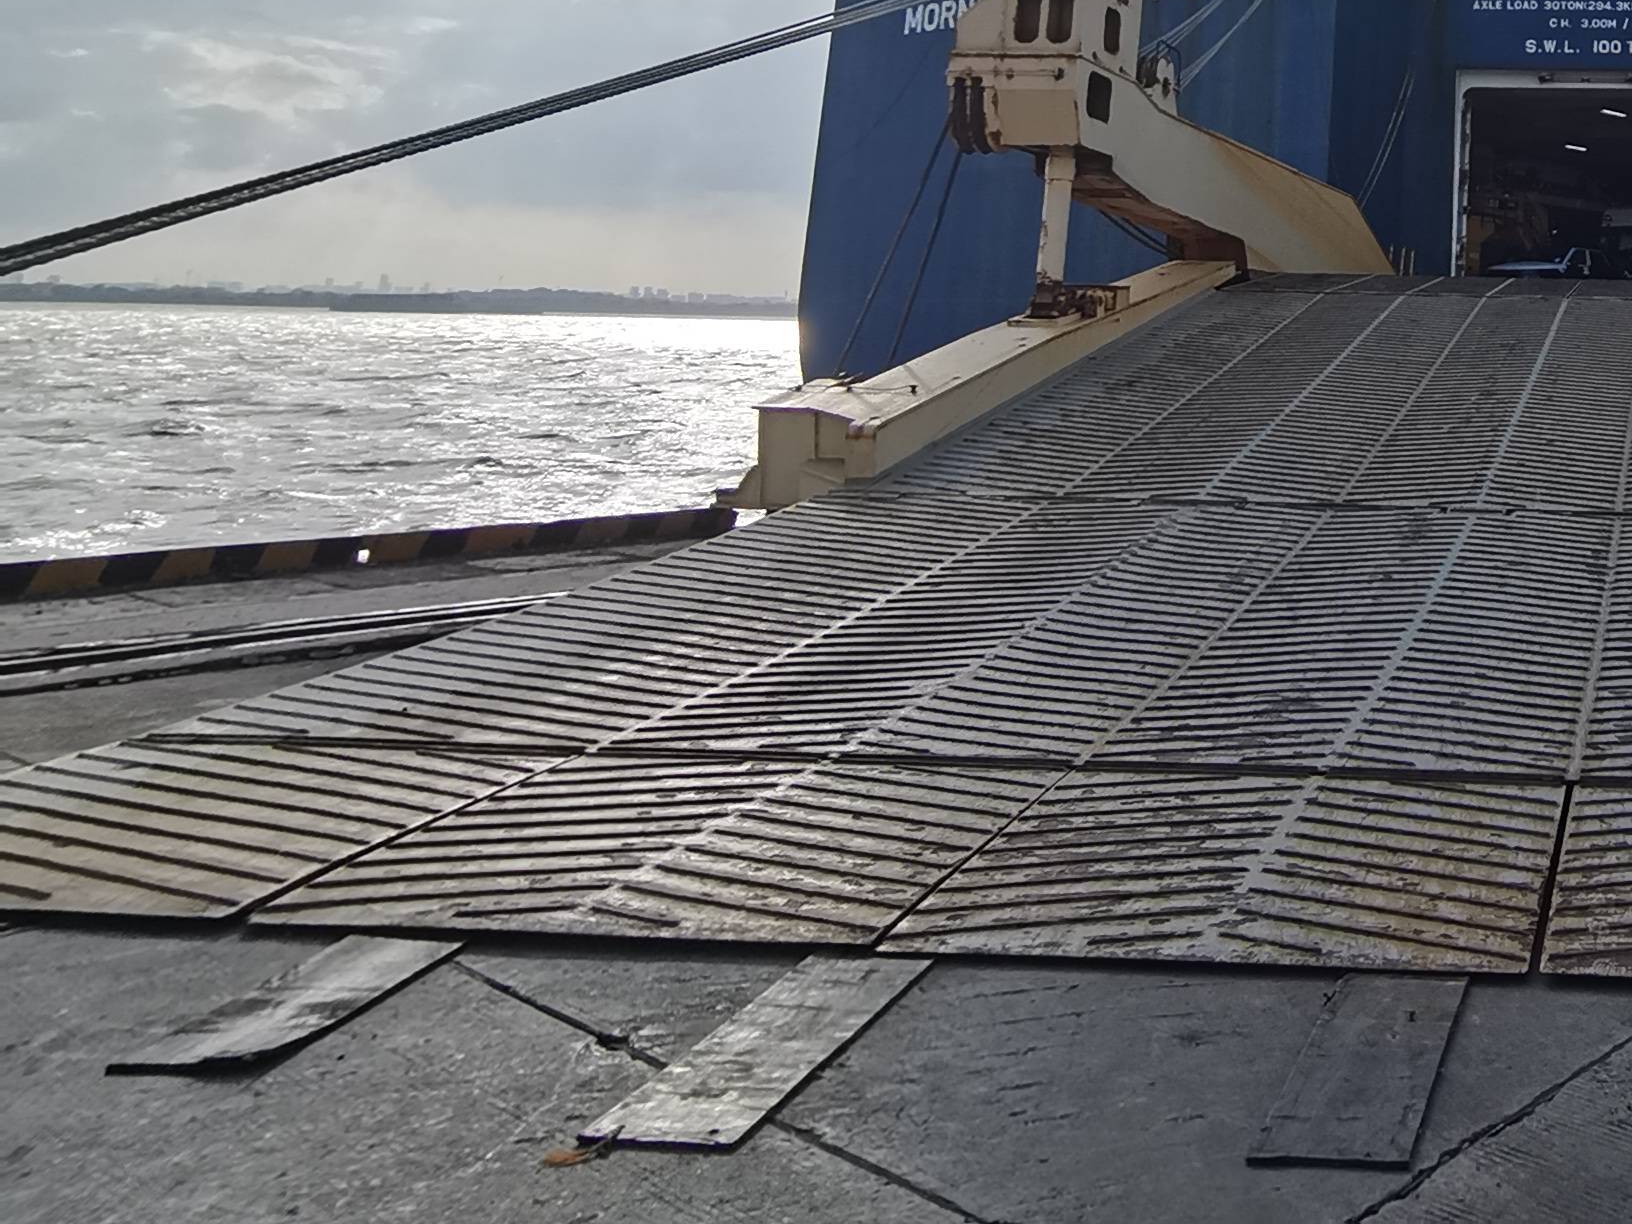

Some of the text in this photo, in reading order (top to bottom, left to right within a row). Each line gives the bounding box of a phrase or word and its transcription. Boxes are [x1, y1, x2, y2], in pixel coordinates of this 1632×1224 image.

[1473, 0, 1502, 10] AXLE
[1507, 0, 1538, 10] LOAD
[1580, 19, 1616, 28] 3.00M
[1525, 39, 1580, 54] S.W.L.
